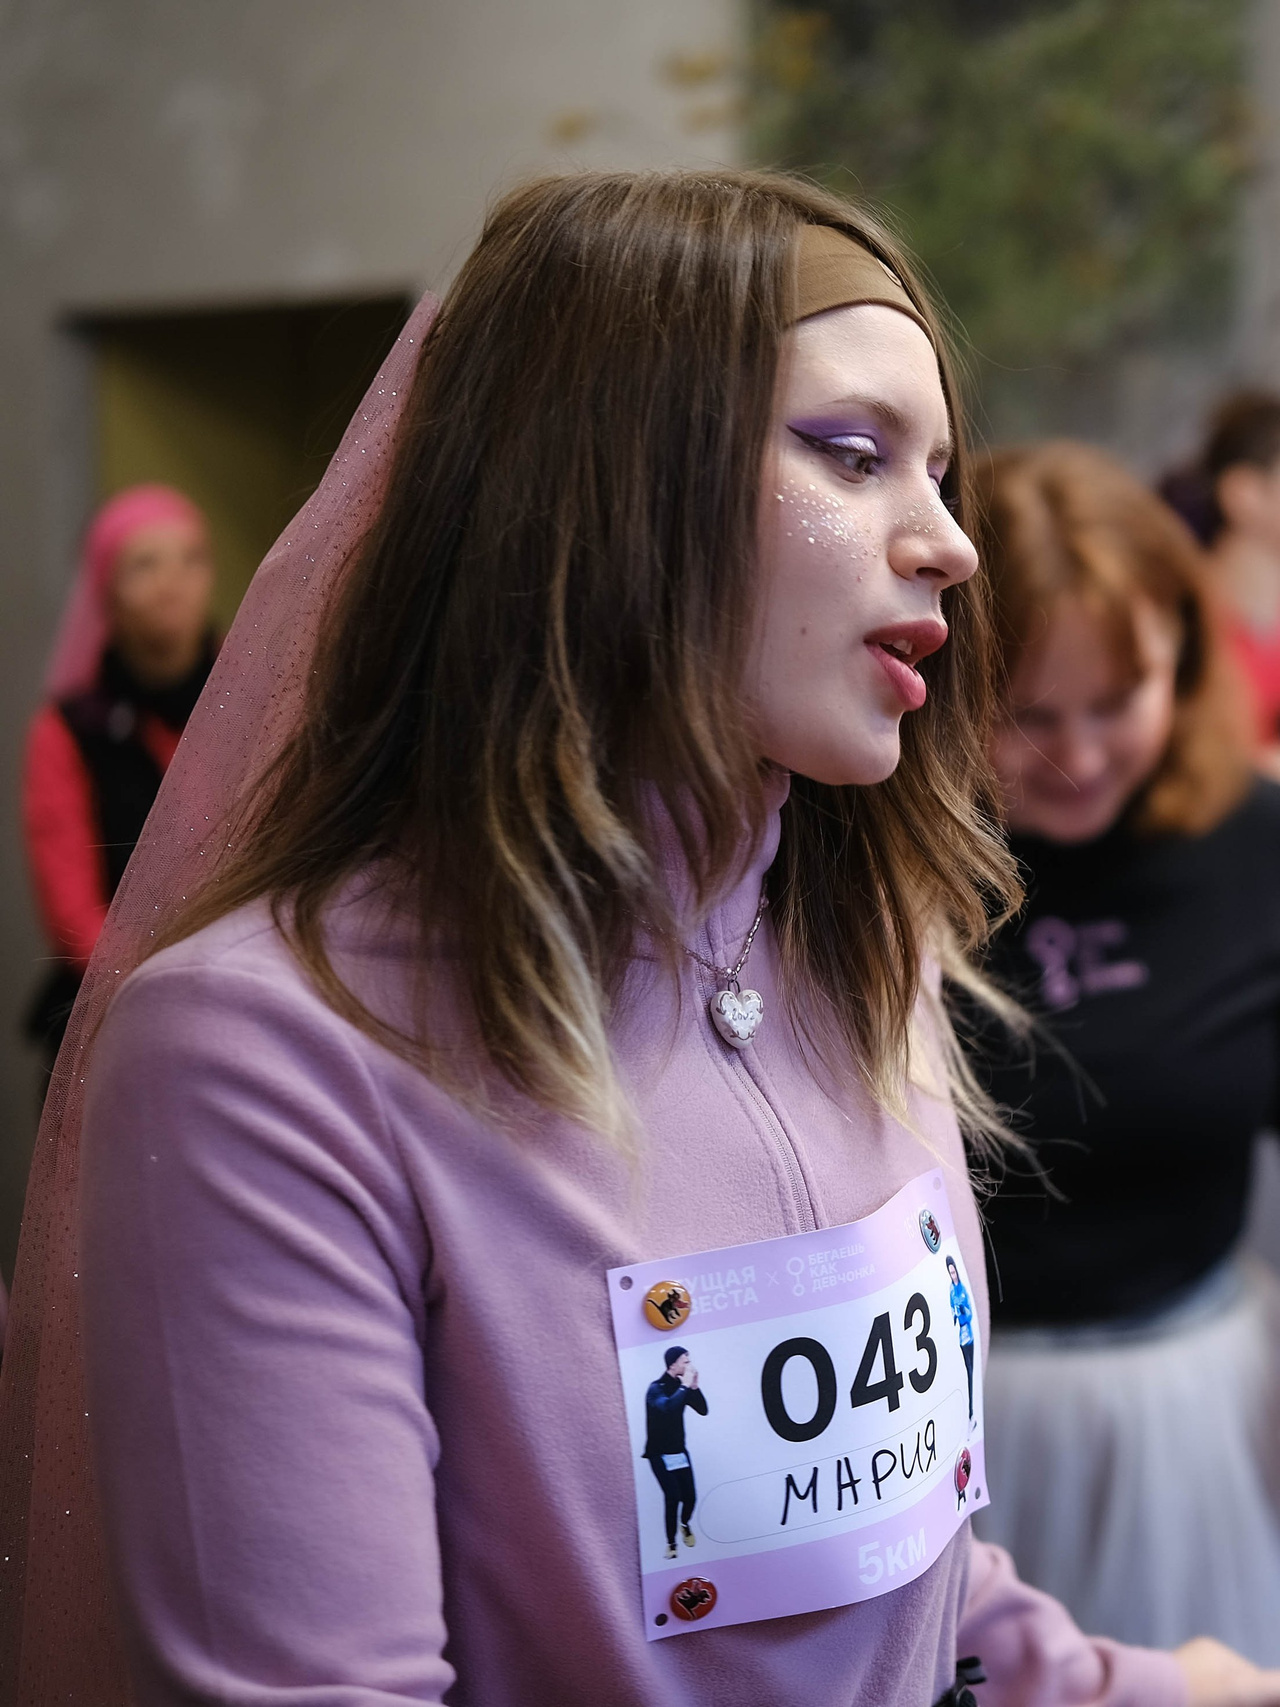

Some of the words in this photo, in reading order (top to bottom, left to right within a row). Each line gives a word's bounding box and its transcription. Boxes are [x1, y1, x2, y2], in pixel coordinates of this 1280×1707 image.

[807, 1243, 865, 1266] БЕГАЕШЬ
[669, 1265, 757, 1294] УЩАЯ
[809, 1262, 838, 1278] КАК
[811, 1263, 877, 1293] ДЕВЧОНКА
[761, 1292, 938, 1442] 043
[780, 1420, 936, 1525] МАРИЯ
